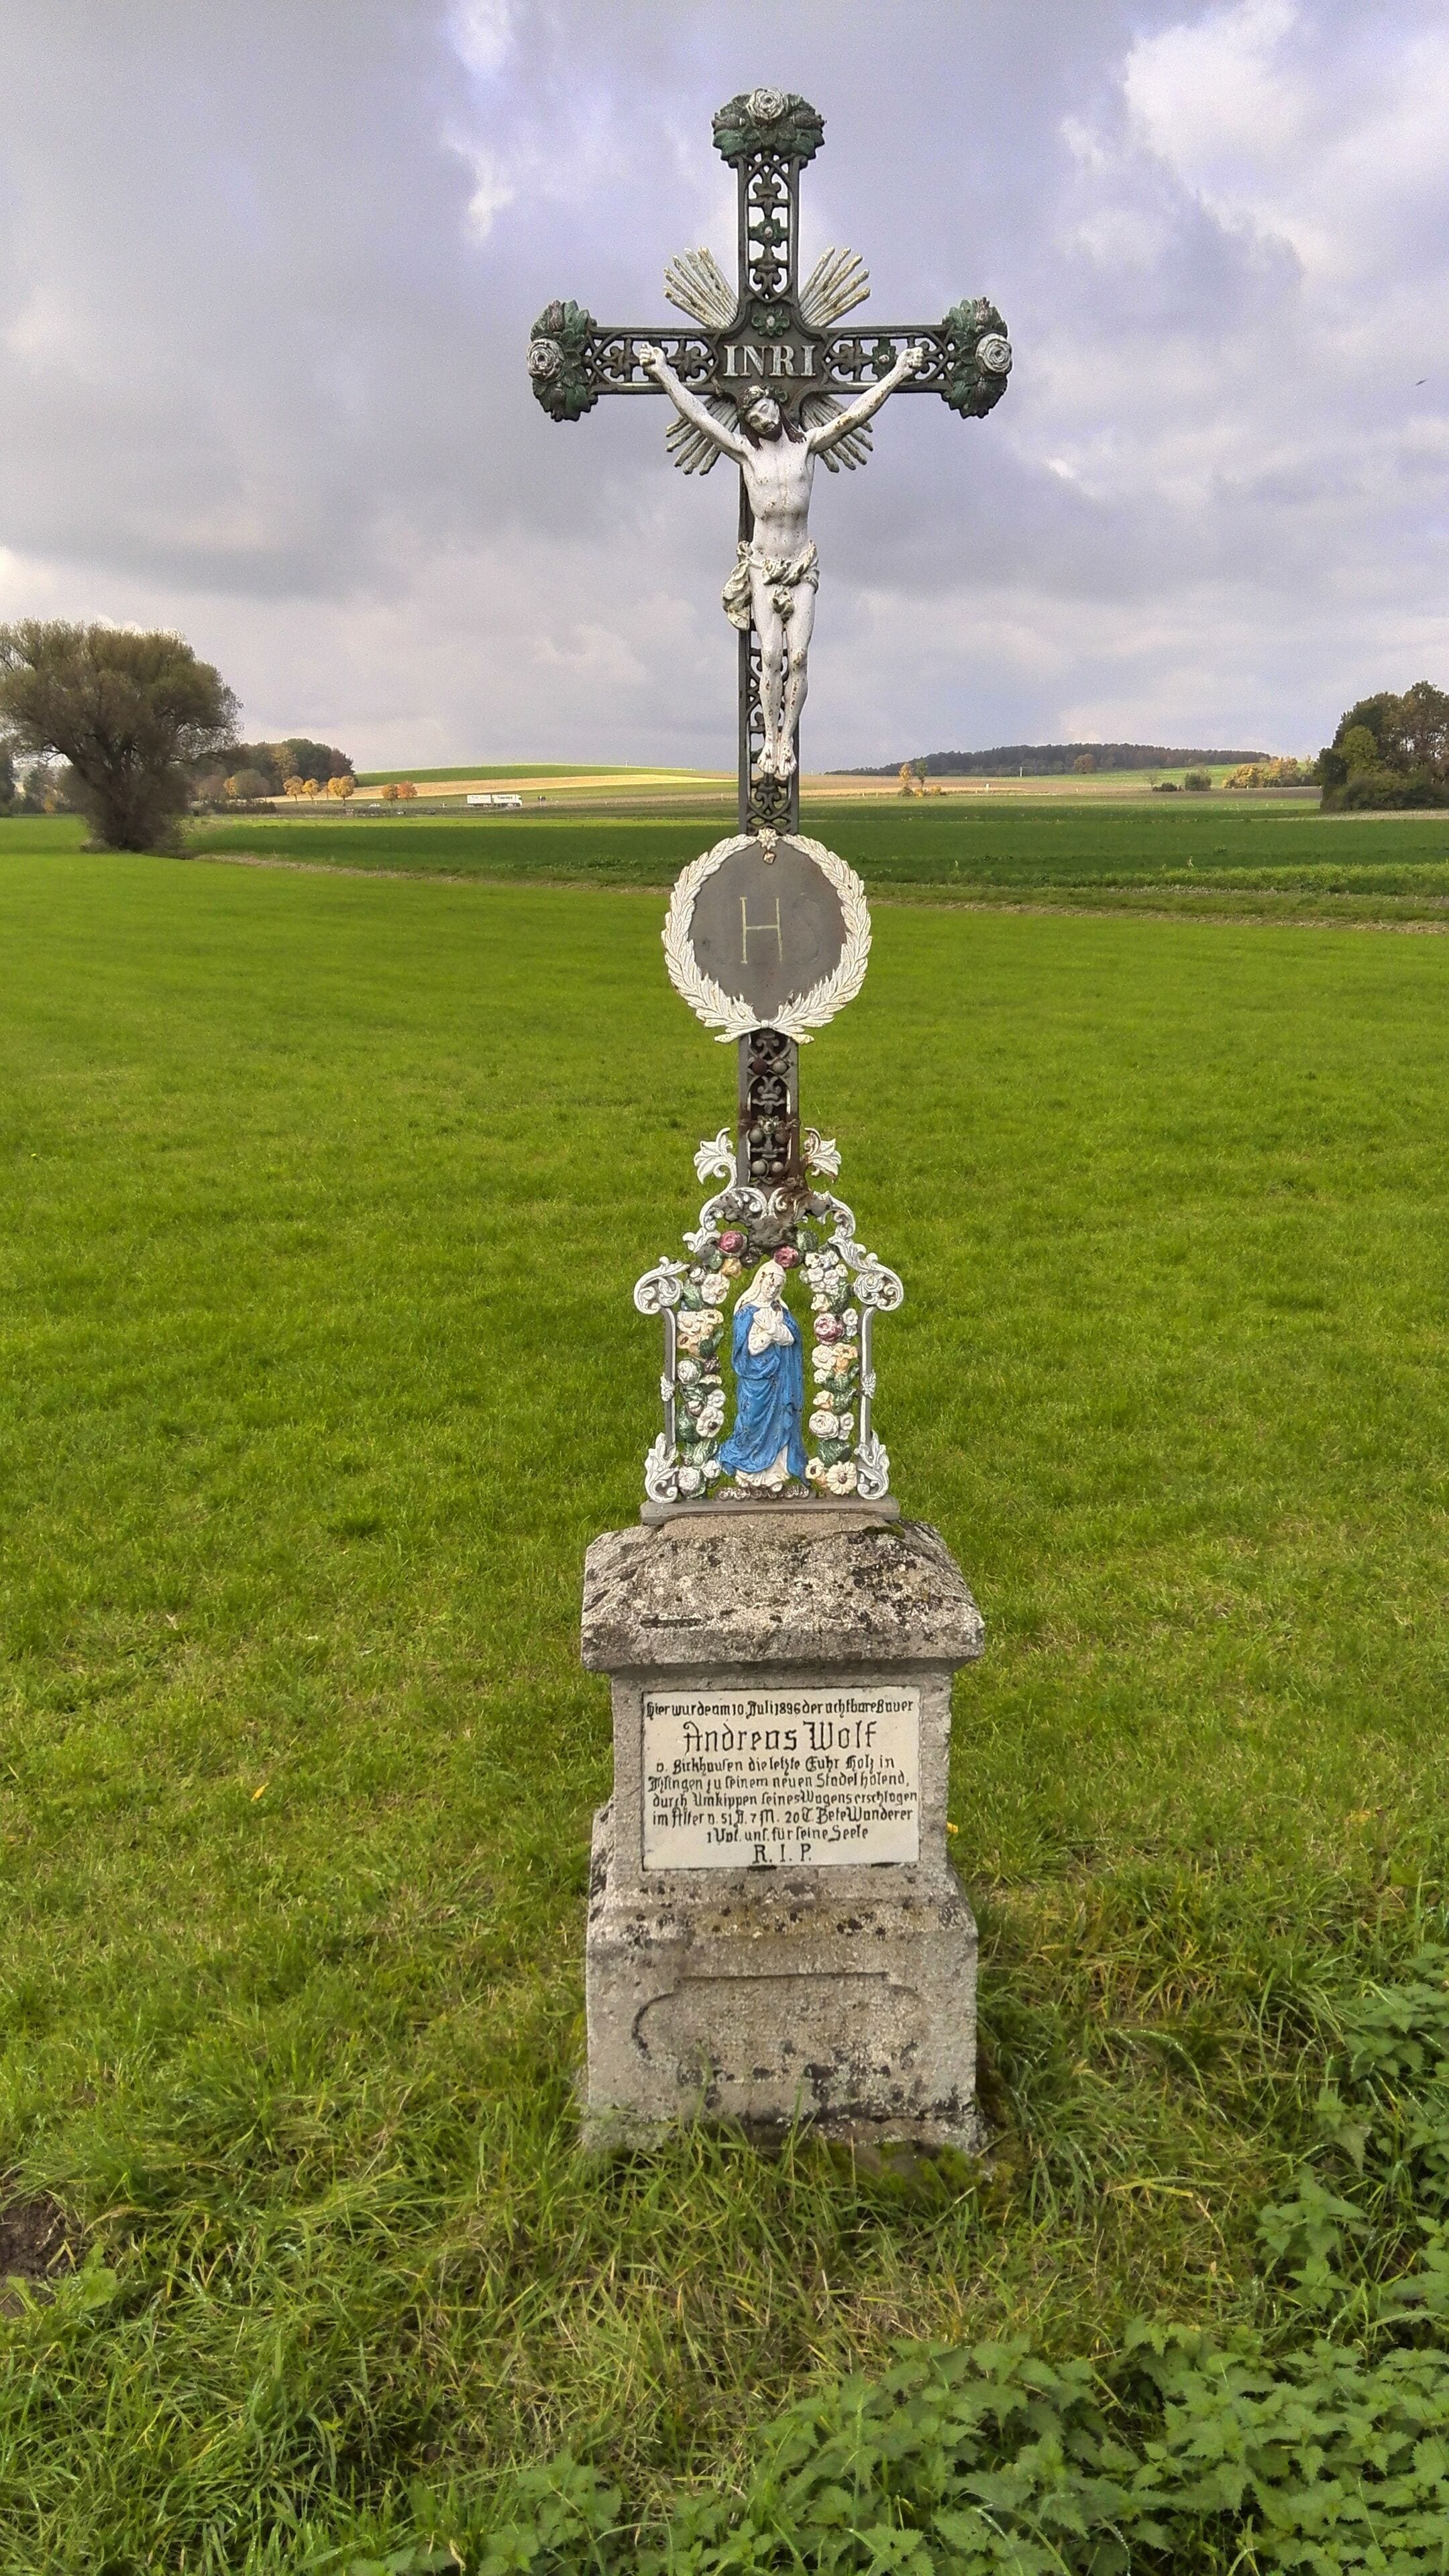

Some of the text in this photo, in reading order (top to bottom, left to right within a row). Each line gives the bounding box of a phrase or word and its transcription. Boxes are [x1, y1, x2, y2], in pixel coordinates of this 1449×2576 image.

[722, 345, 816, 376] INRI
[740, 897, 783, 964] H
[647, 1702, 669, 1721] Hier
[670, 1701, 711, 1717] wurde
[712, 1703, 731, 1716] am
[745, 1700, 774, 1719] Juli
[774, 1702, 801, 1716] 1896
[802, 1699, 823, 1715] der
[825, 1698, 876, 1719] achtbare
[875, 1699, 914, 1714] Bauer
[683, 1719, 877, 1755] Andreas Wolf
[672, 1756, 743, 1776] Birkhausen
[748, 1756, 767, 1772] die
[769, 1756, 800, 1776] letzte
[805, 1755, 839, 1772] Fuhr
[845, 1754, 874, 1774] Holz
[879, 1755, 895, 1769] in
[772, 1776, 813, 1788] neuen
[816, 1772, 858, 1788] Stadel
[653, 1792, 688, 1811] durch
[692, 1791, 757, 1810] Umkippen
[800, 1789, 853, 1808] Wagens
[854, 1790, 917, 1807] erschlagen
[653, 1811, 669, 1826] im
[671, 1807, 704, 1829] Alter
[721, 1813, 733, 1825] 51
[750, 1813, 757, 1823] 7
[785, 1811, 800, 1823] 20
[816, 1807, 847, 1825] Bete
[846, 1805, 913, 1822] Wanderer
[771, 1826, 794, 1841] für
[827, 1824, 868, 1842] Seele
